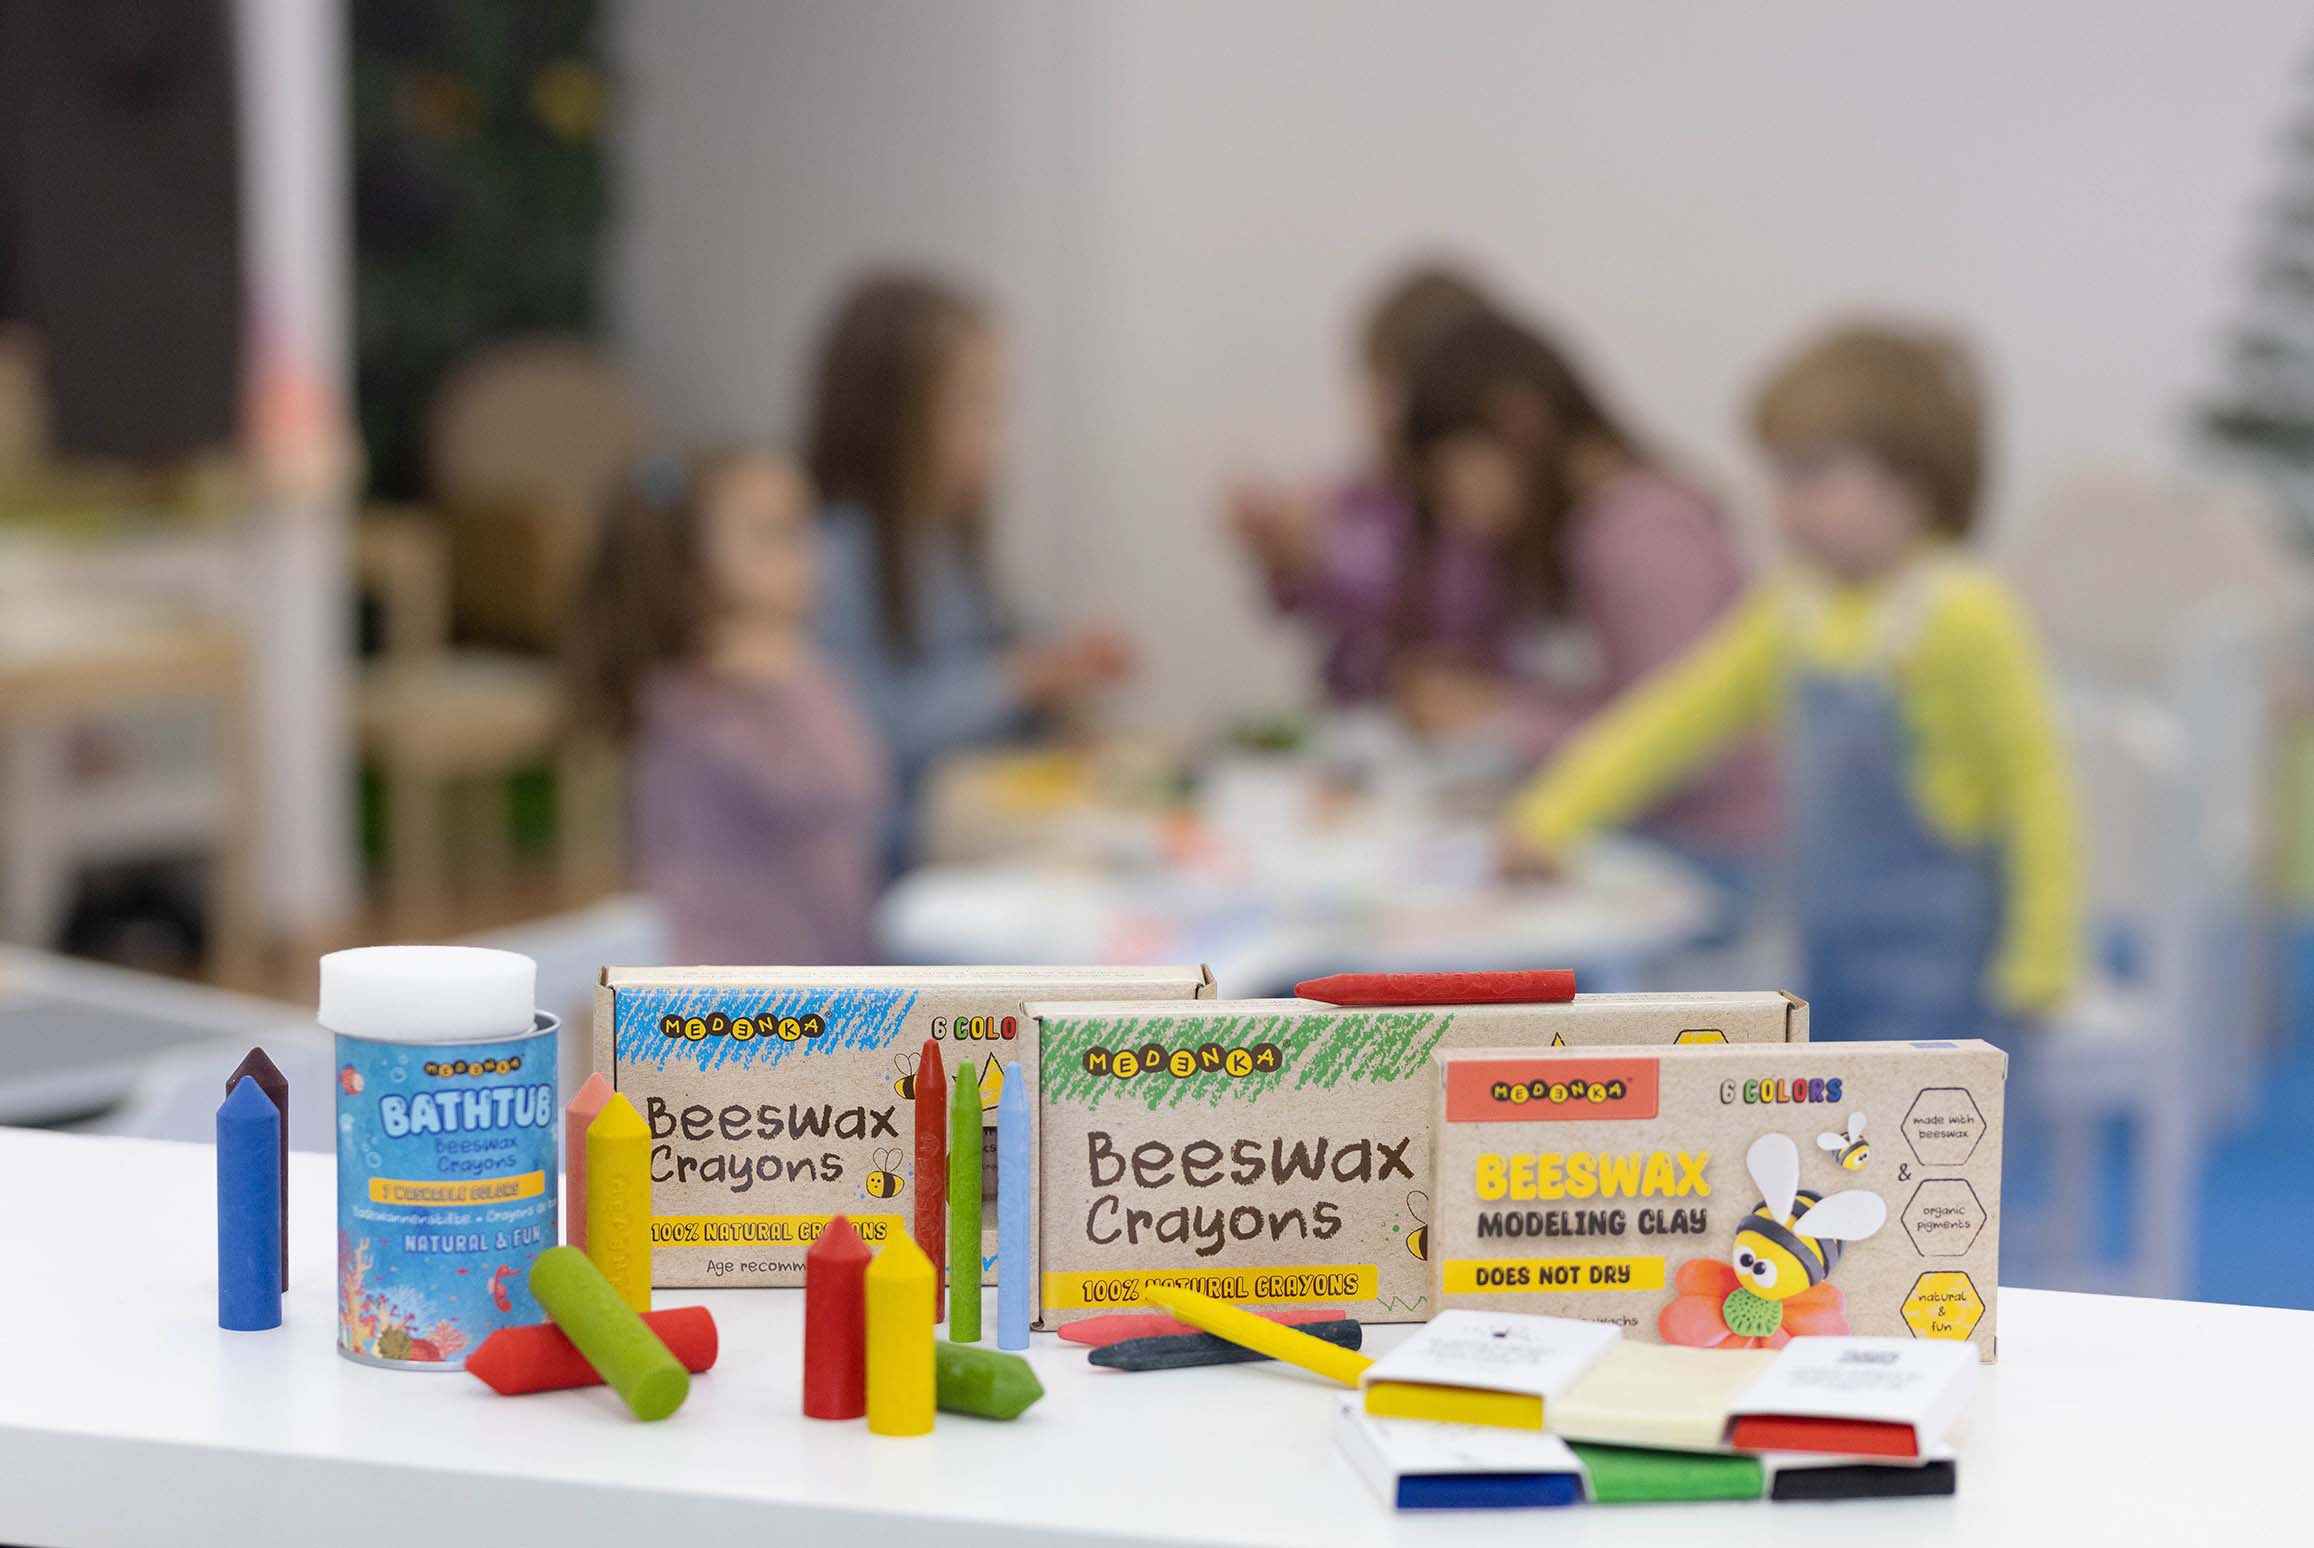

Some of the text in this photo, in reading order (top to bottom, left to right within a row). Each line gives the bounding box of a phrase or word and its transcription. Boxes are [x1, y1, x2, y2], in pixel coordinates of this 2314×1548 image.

[932, 1016, 1017, 1040] 6 COLO
[1720, 1078, 1843, 1104] 6 COLORS
[380, 1083, 552, 1139] BATHTUB
[647, 1096, 900, 1141] Beeswax
[1913, 1114, 1974, 1125] made with
[1919, 1129, 1968, 1139] beeswax
[435, 1137, 519, 1154] Beeswax
[437, 1155, 518, 1175] Crayons
[650, 1144, 844, 1193] Crayons
[1087, 1131, 1415, 1189] Beeswax
[1475, 1151, 1712, 1200] BEESWAX
[1898, 1163, 1912, 1181] &
[1923, 1206, 1966, 1218] organic
[651, 1222, 888, 1241] 100% NATURAL CRONS
[1086, 1194, 1343, 1258] Crayons
[1478, 1208, 1708, 1238] MODELING CLAY
[1917, 1220, 1970, 1233] pigments
[404, 1224, 541, 1254] NATURAL & FUN
[706, 1259, 807, 1277] Age recomm
[1475, 1264, 1632, 1286] DOES NOT DRY
[1083, 1279, 1140, 1302] 100%
[1254, 1273, 1360, 1298] CRAYONS
[1918, 1290, 1967, 1302] natural
[1937, 1307, 1946, 1317] &
[1931, 1321, 1952, 1332] fun
